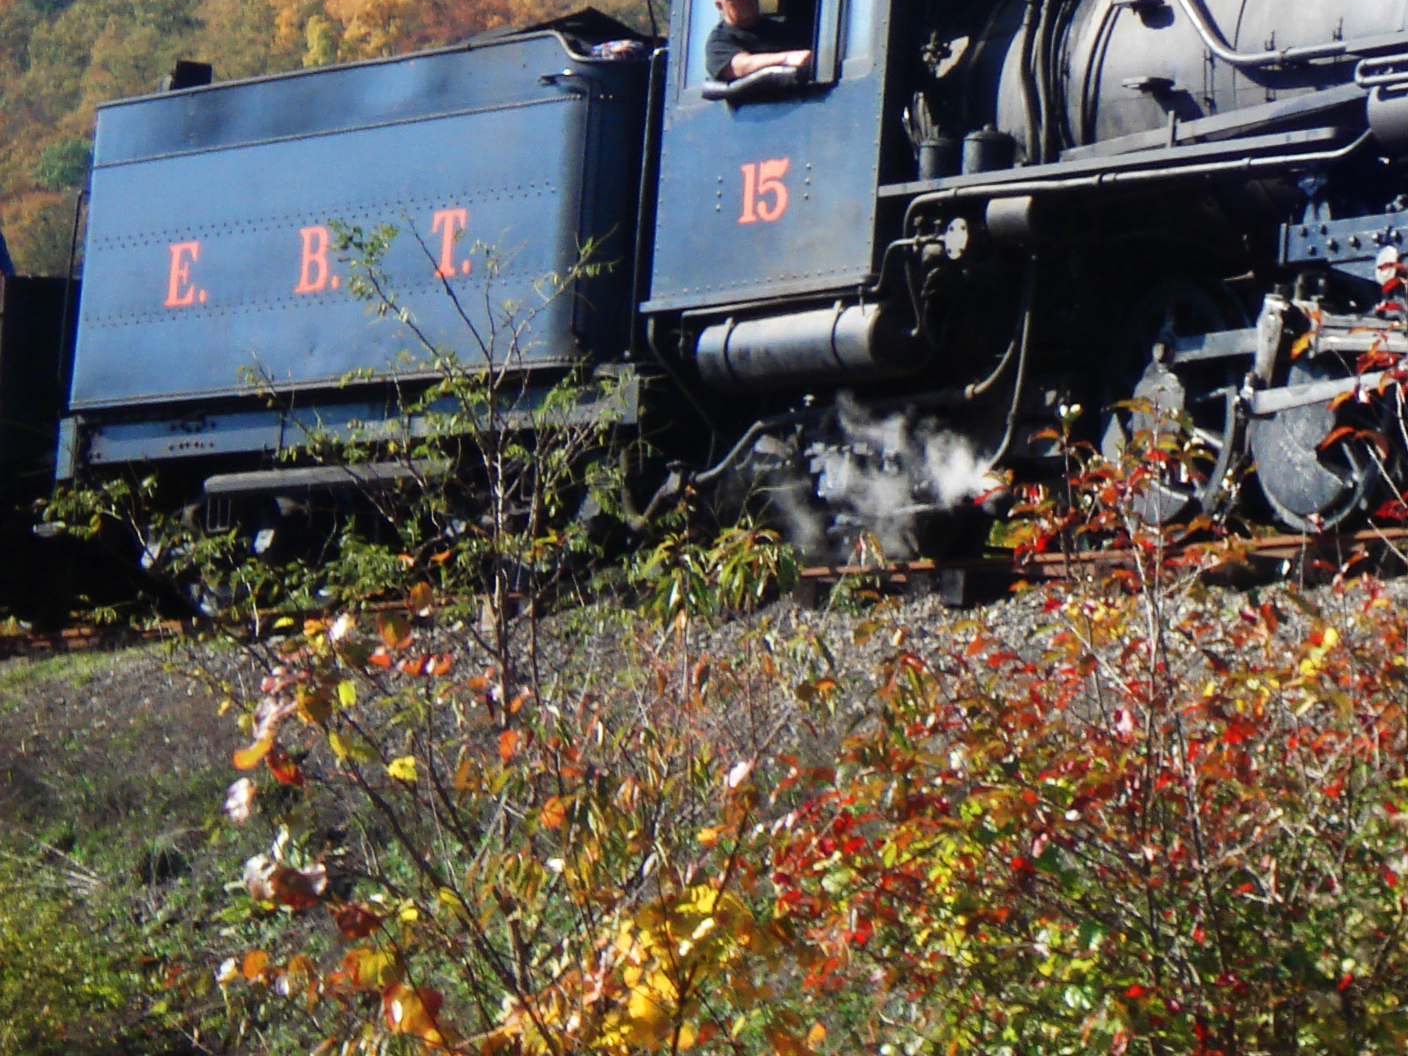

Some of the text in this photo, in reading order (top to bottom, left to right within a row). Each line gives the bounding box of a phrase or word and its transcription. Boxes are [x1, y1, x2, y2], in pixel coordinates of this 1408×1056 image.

[738, 157, 790, 224] 15
[164, 208, 472, 307] E. B. T.
